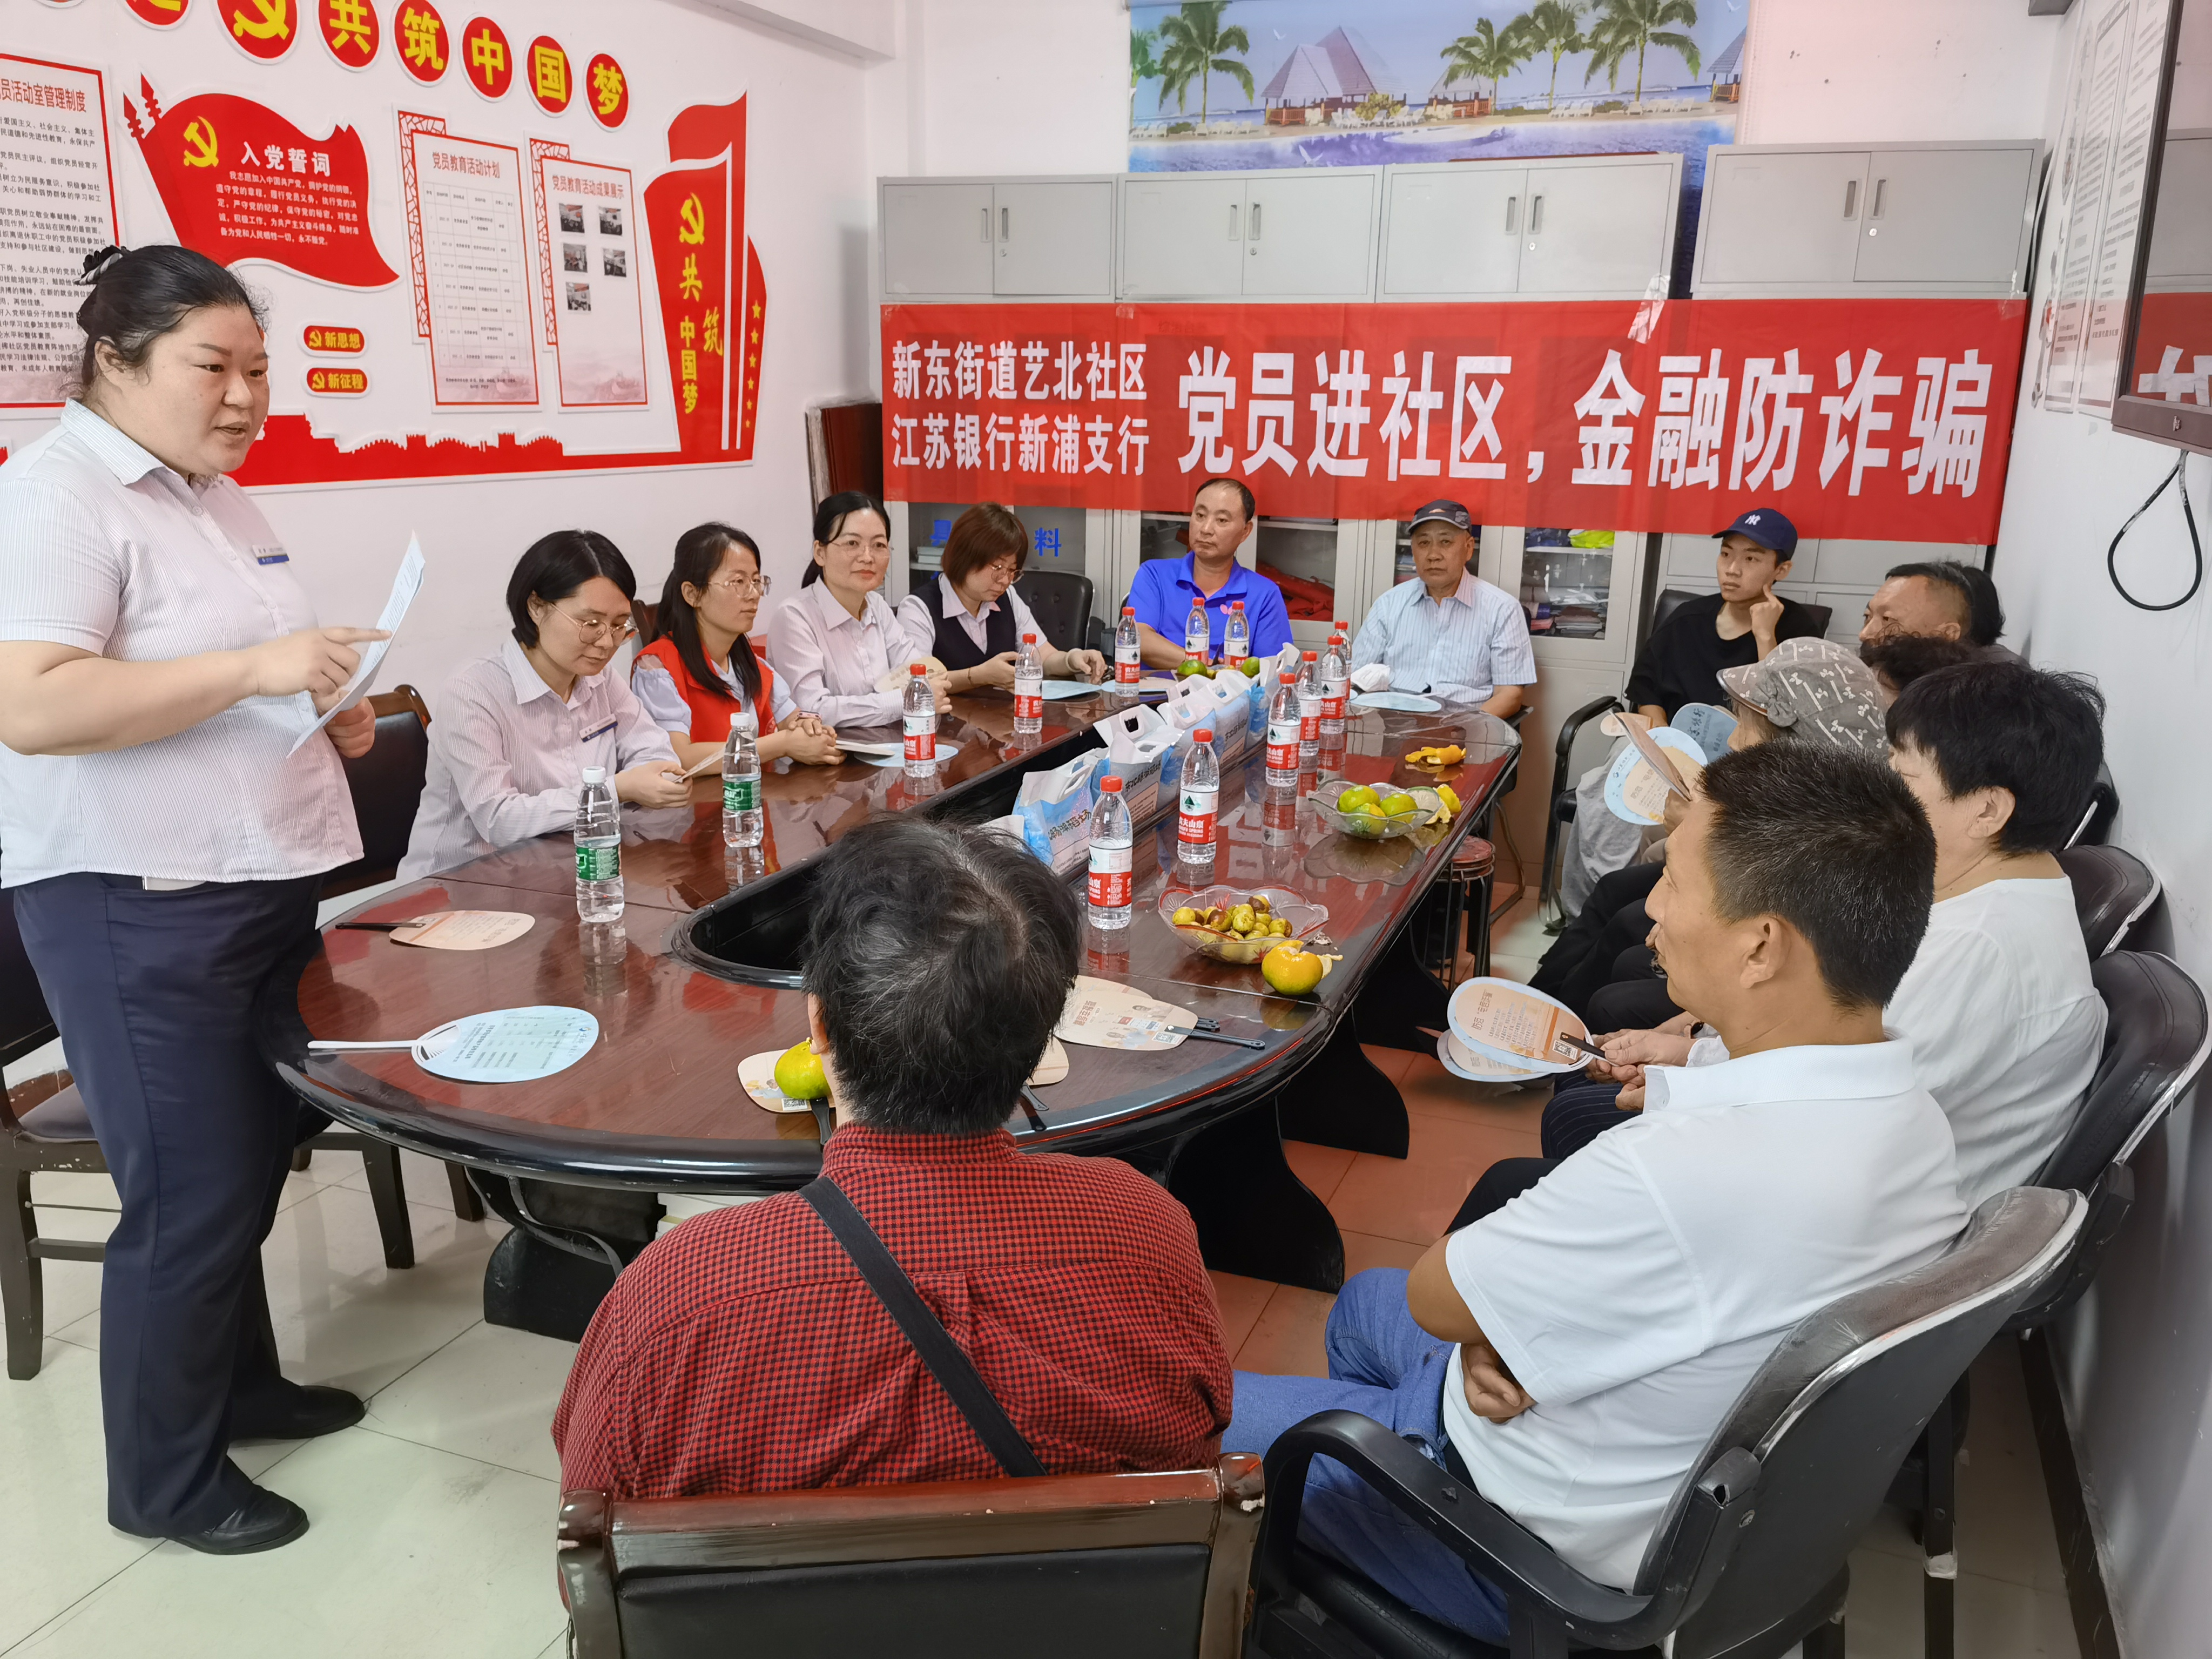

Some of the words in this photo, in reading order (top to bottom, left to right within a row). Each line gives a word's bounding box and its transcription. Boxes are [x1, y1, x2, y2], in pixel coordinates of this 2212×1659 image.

[0, 78, 86, 112] 员活动室管理制度
[241, 141, 331, 177] 入党誓词
[432, 152, 500, 179] 党员教育活动计划
[892, 340, 1147, 401] 新东街道艺北社区
[892, 412, 1149, 476] 江苏银行新浦支行
[1034, 527, 1062, 557] 料
